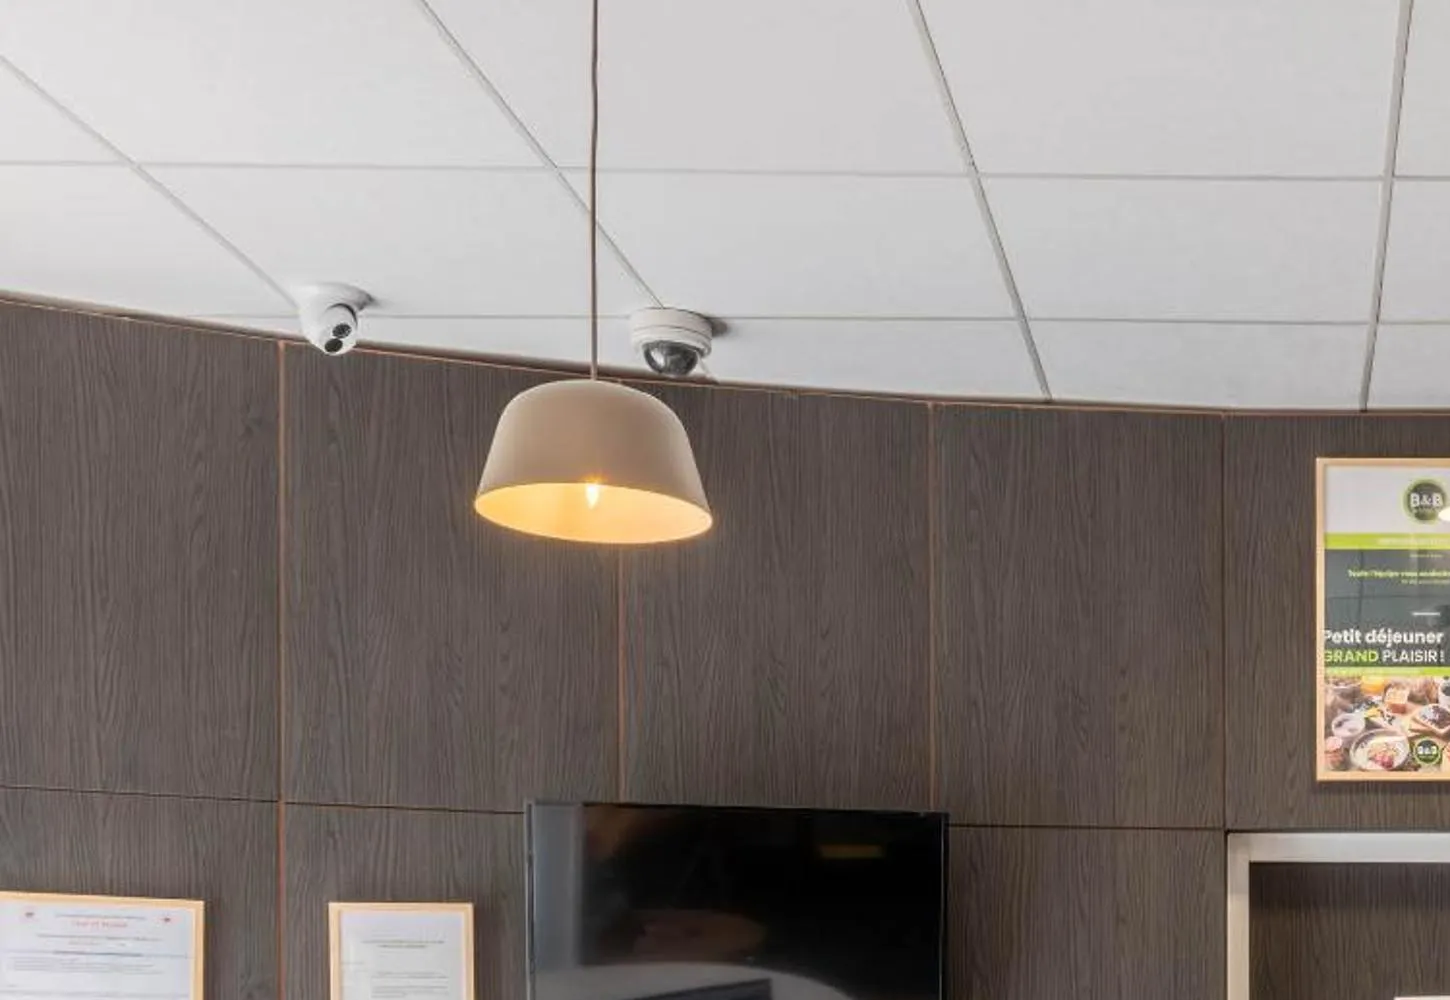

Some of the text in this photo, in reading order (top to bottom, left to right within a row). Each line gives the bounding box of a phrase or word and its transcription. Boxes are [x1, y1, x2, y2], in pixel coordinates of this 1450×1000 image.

[1410, 492, 1443, 507] B&B
[1323, 627, 1444, 649] Petit déjeuner
[1323, 649, 1379, 663] GRAND
